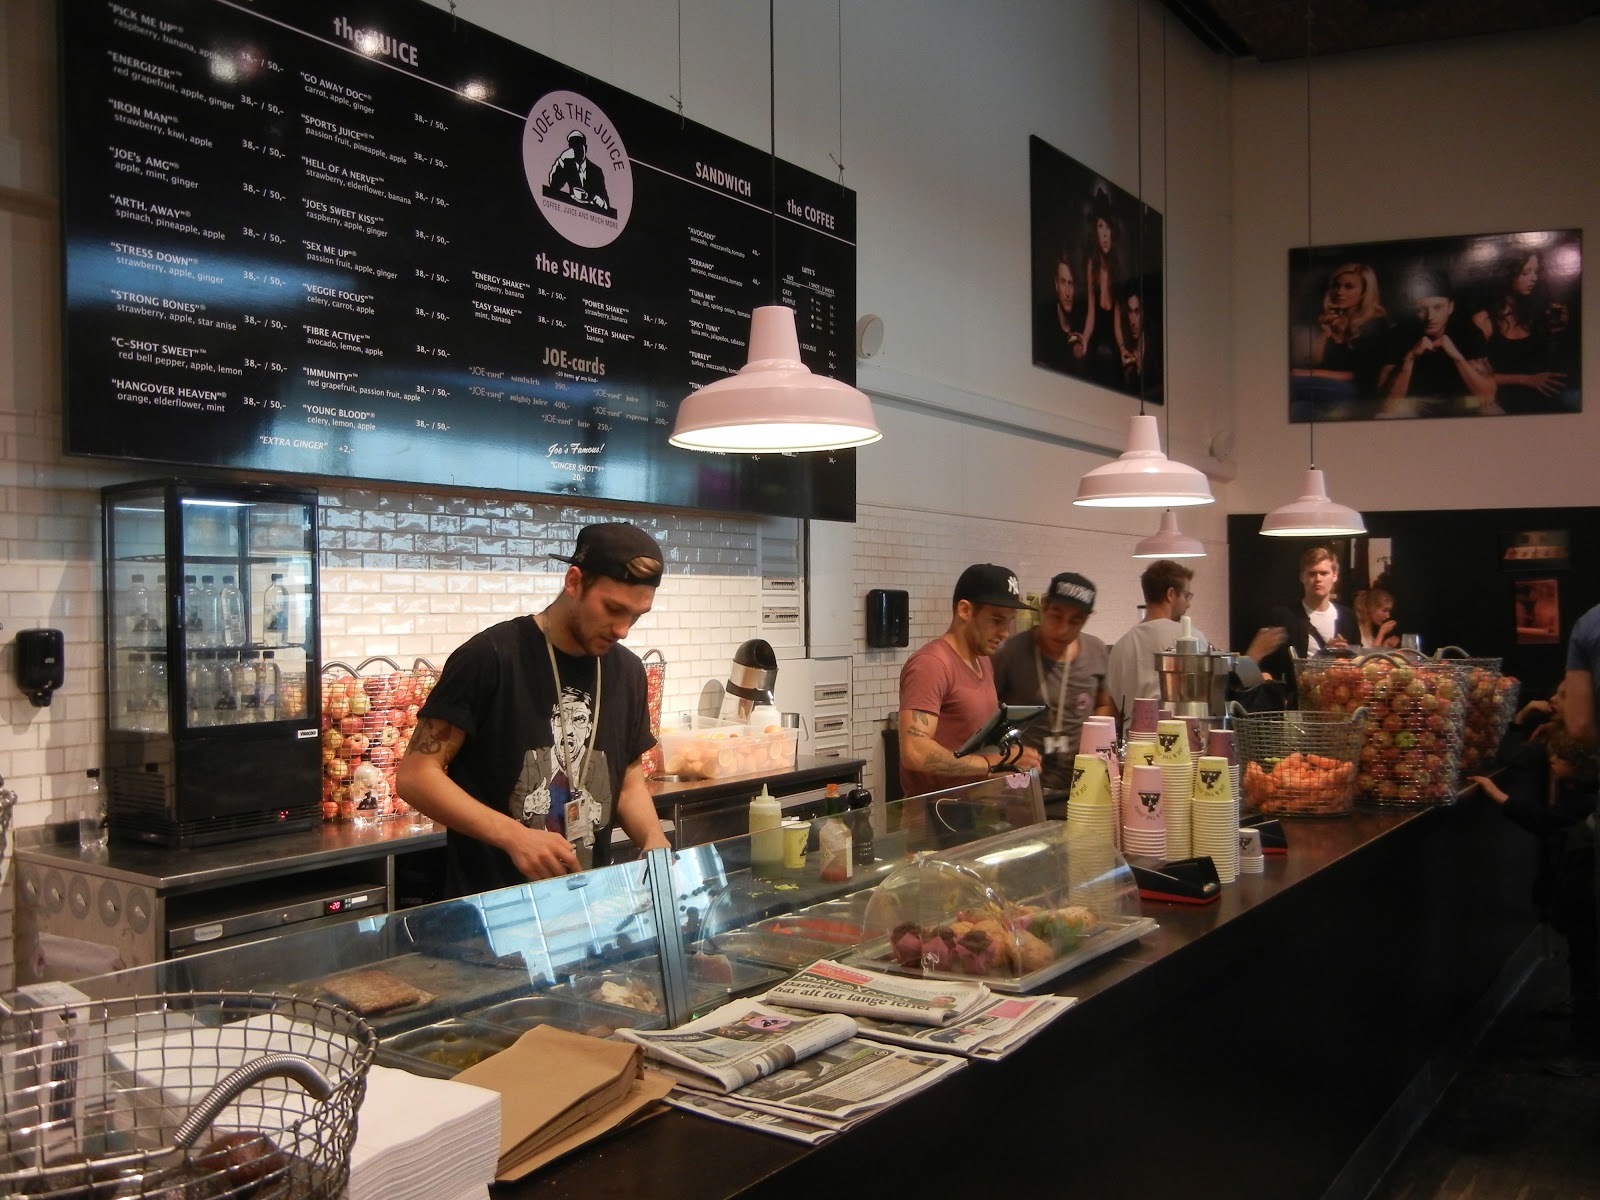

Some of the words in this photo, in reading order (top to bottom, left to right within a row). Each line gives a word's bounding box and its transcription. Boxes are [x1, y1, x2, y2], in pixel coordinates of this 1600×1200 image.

[333, 16, 363, 41] the
[375, 32, 419, 67] JUICE
[319, 78, 344, 94] AWAY
[353, 102, 375, 114] ginger
[190, 134, 213, 148] apple
[532, 109, 554, 143] JOE
[553, 104, 565, 120] &
[566, 103, 592, 127] THE
[594, 124, 625, 171] JUICE
[305, 127, 333, 141] passion
[389, 153, 407, 165] apple
[171, 175, 199, 189] ginger
[695, 162, 751, 197] SANDWICH
[388, 192, 412, 205] banana
[563, 207, 577, 217] JUICE
[578, 211, 589, 221] AND
[590, 215, 604, 224] MUCH
[605, 219, 618, 229] MORE
[787, 199, 802, 217] the
[805, 206, 835, 230] COFFEE
[202, 228, 226, 240] apple
[366, 227, 388, 238] ginger
[324, 246, 336, 255] ME
[307, 253, 334, 265] passion
[376, 269, 398, 280] ginger
[535, 252, 558, 274] the
[562, 260, 612, 288] SHAKES
[198, 273, 224, 285] ginger
[505, 288, 525, 298] banana
[357, 305, 375, 315] apple
[198, 317, 213, 327] star
[216, 321, 237, 331] anise
[365, 348, 383, 357] apple
[119, 351, 133, 360] red
[137, 352, 152, 362] bell
[218, 364, 243, 376] lemon
[542, 347, 606, 376] JOE-cards
[359, 388, 385, 396] passion
[403, 393, 421, 402] apple
[206, 403, 225, 412] mint
[358, 423, 376, 431] apple
[571, 443, 605, 455] Famous!
[799, 987, 820, 996] alt
[823, 990, 846, 1000] for
[847, 993, 888, 1006] lange
